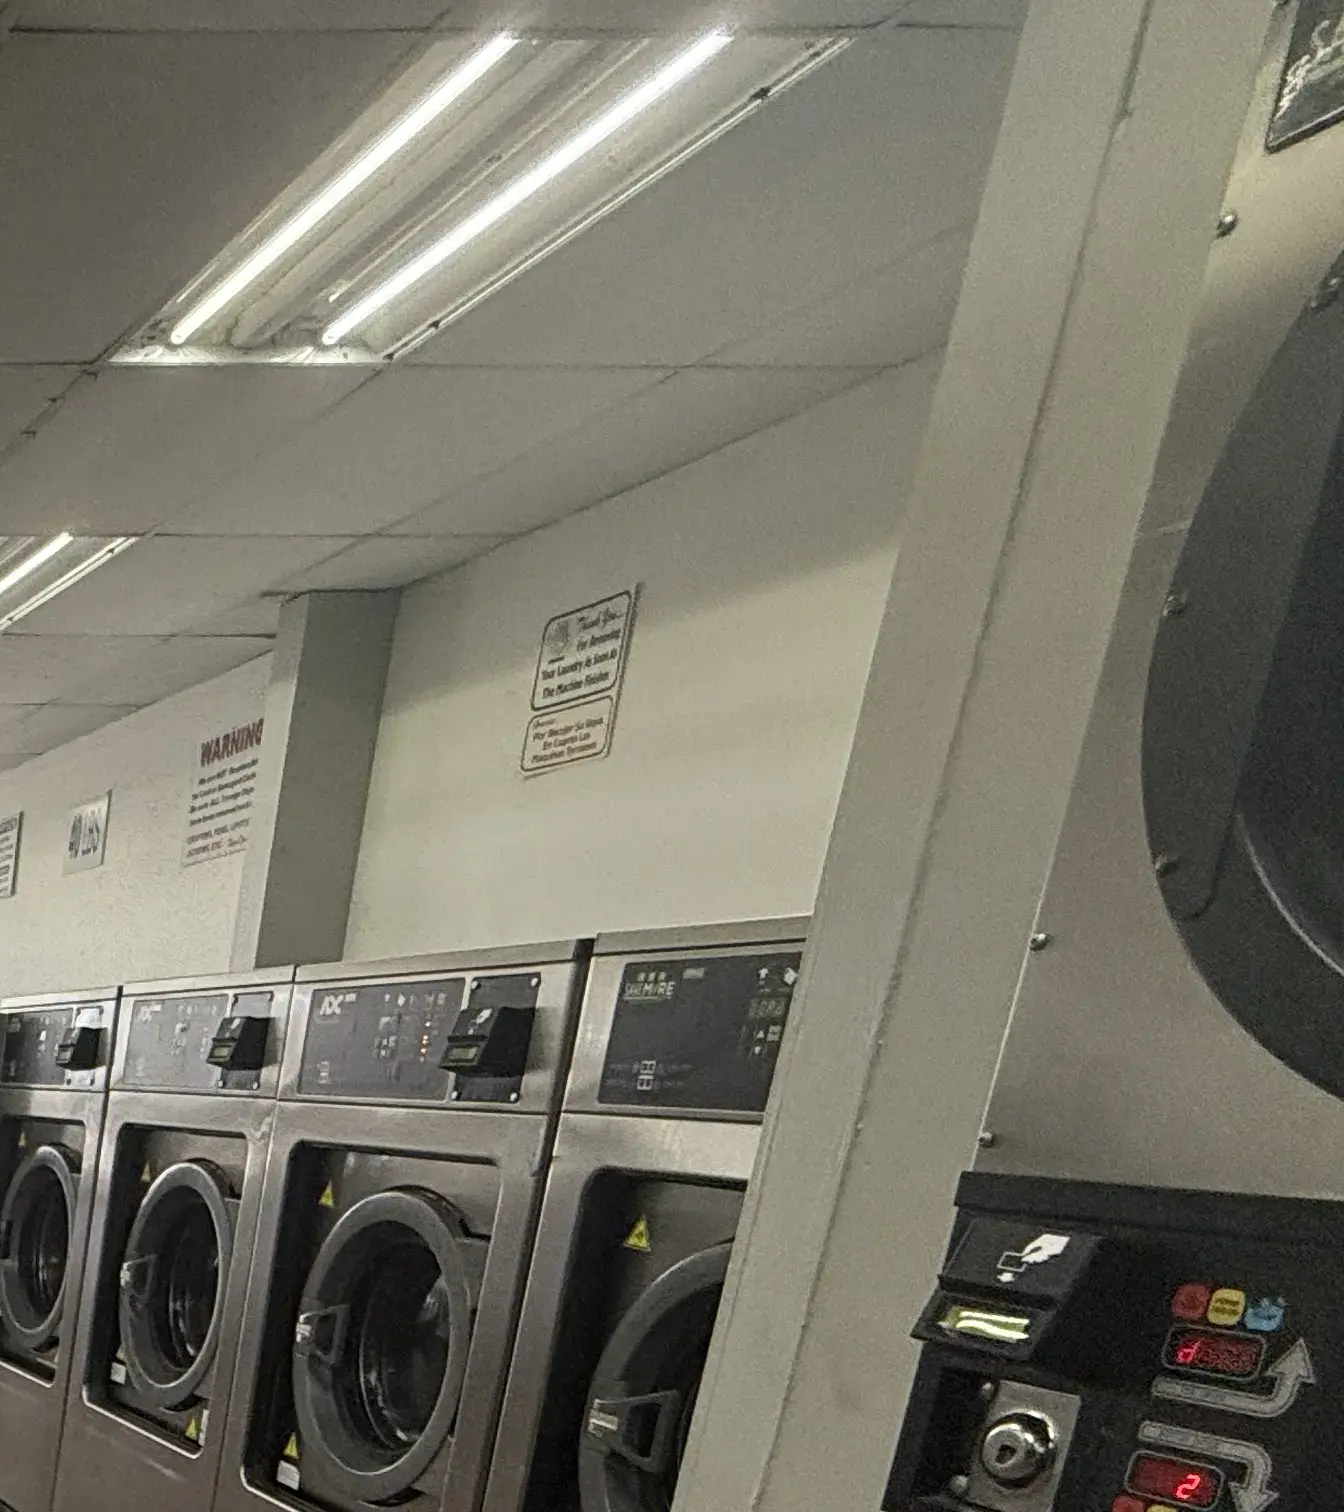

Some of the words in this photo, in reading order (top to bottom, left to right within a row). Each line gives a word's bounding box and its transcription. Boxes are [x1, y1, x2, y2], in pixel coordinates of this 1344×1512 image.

[557, 659, 583, 676] Laundry
[542, 685, 555, 699] The
[556, 678, 583, 696] Machine
[200, 718, 264, 767] WARNING
[1175, 1473, 1201, 1500] 2
